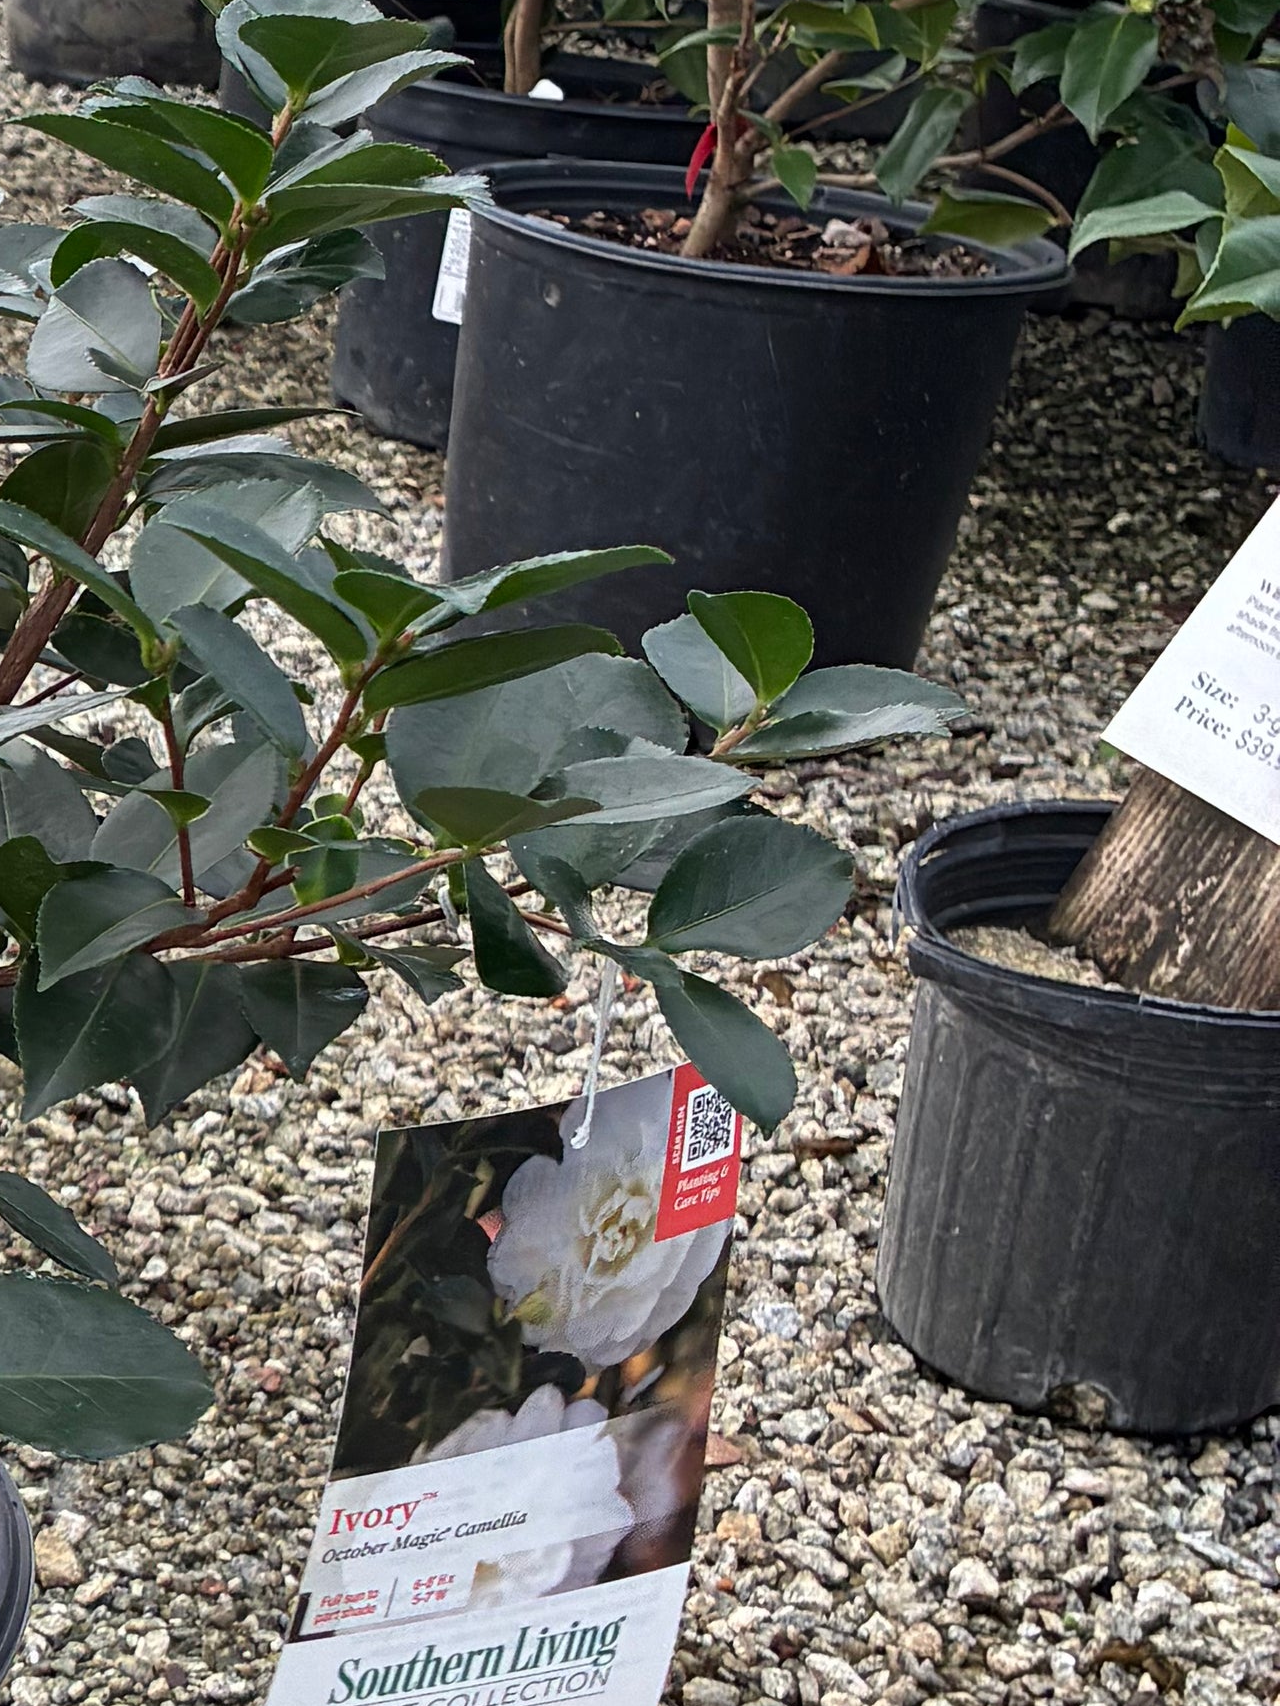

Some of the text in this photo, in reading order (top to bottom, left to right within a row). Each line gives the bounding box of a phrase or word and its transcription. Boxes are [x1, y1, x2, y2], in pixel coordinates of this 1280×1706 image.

[1174, 695, 1231, 740] Price:
[1191, 671, 1280, 737] Size: 3-g
[673, 1186, 721, 1211] Care Tips
[321, 1542, 390, 1564] October
[454, 1510, 529, 1539] Camellia
[327, 1614, 627, 1705] Southern Living
